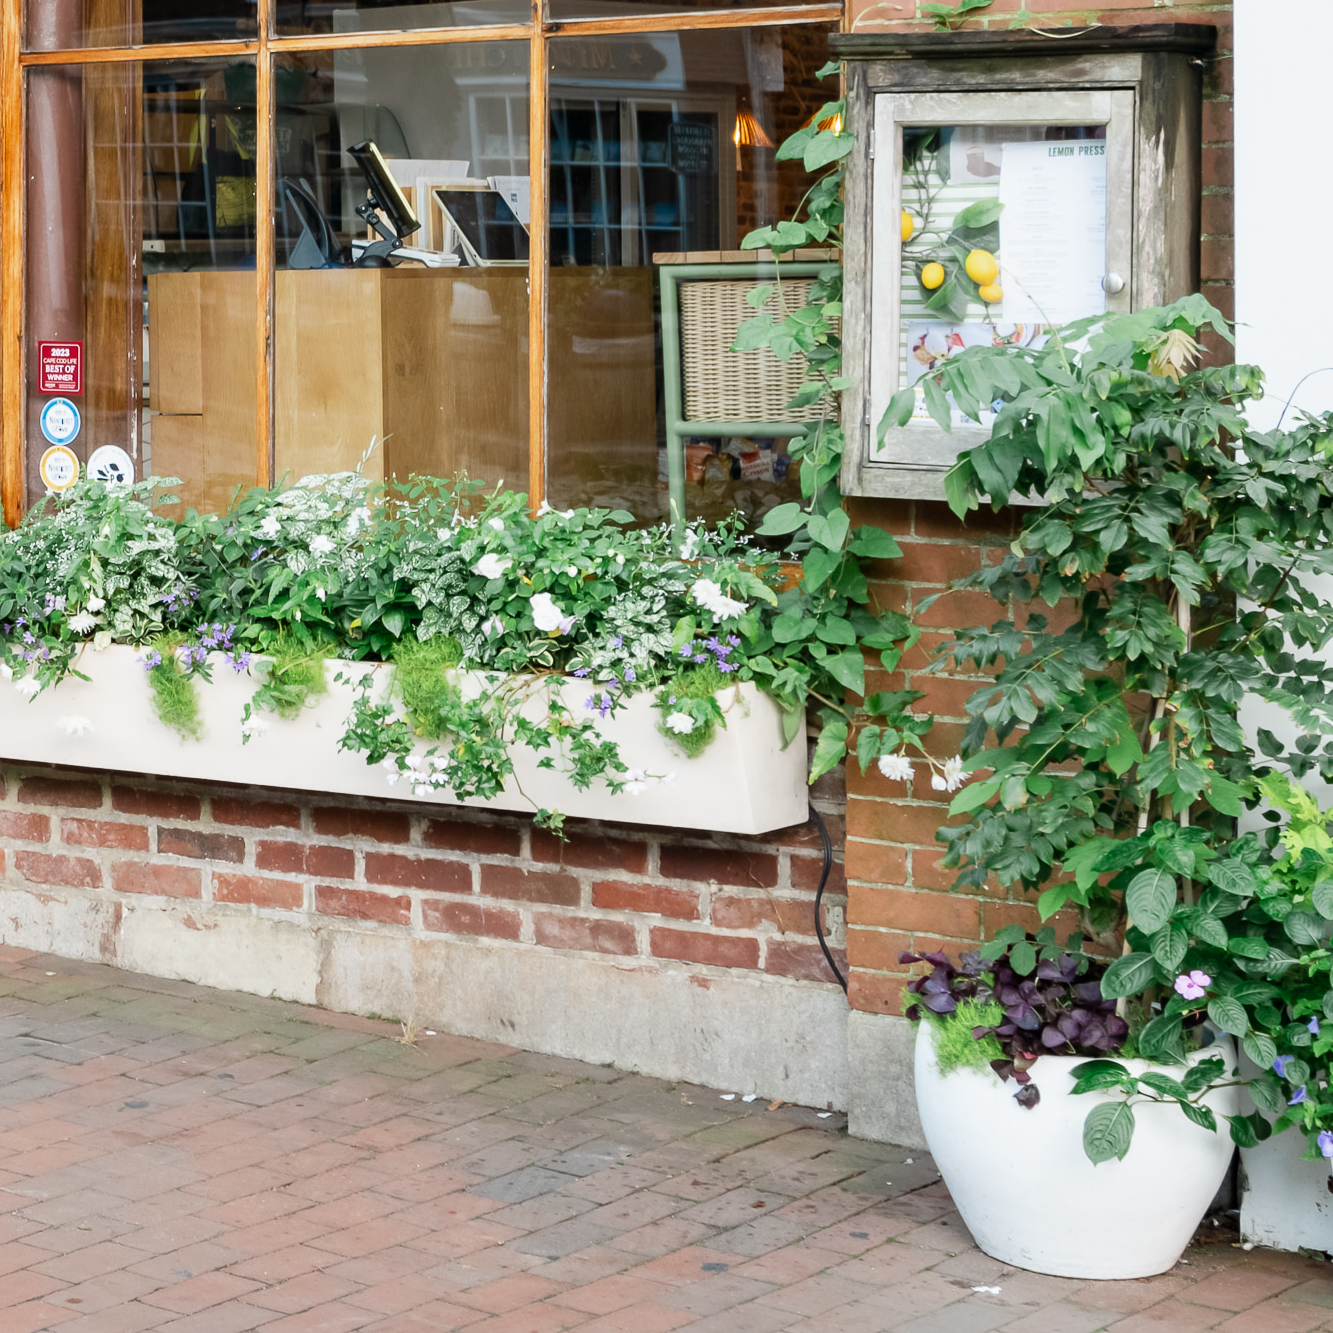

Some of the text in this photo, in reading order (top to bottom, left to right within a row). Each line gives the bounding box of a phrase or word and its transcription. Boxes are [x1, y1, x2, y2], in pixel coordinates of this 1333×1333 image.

[1048, 145, 1105, 157] LEMON PRESS
[51, 348, 70, 357] 2023
[45, 364, 76, 373] BEST OF
